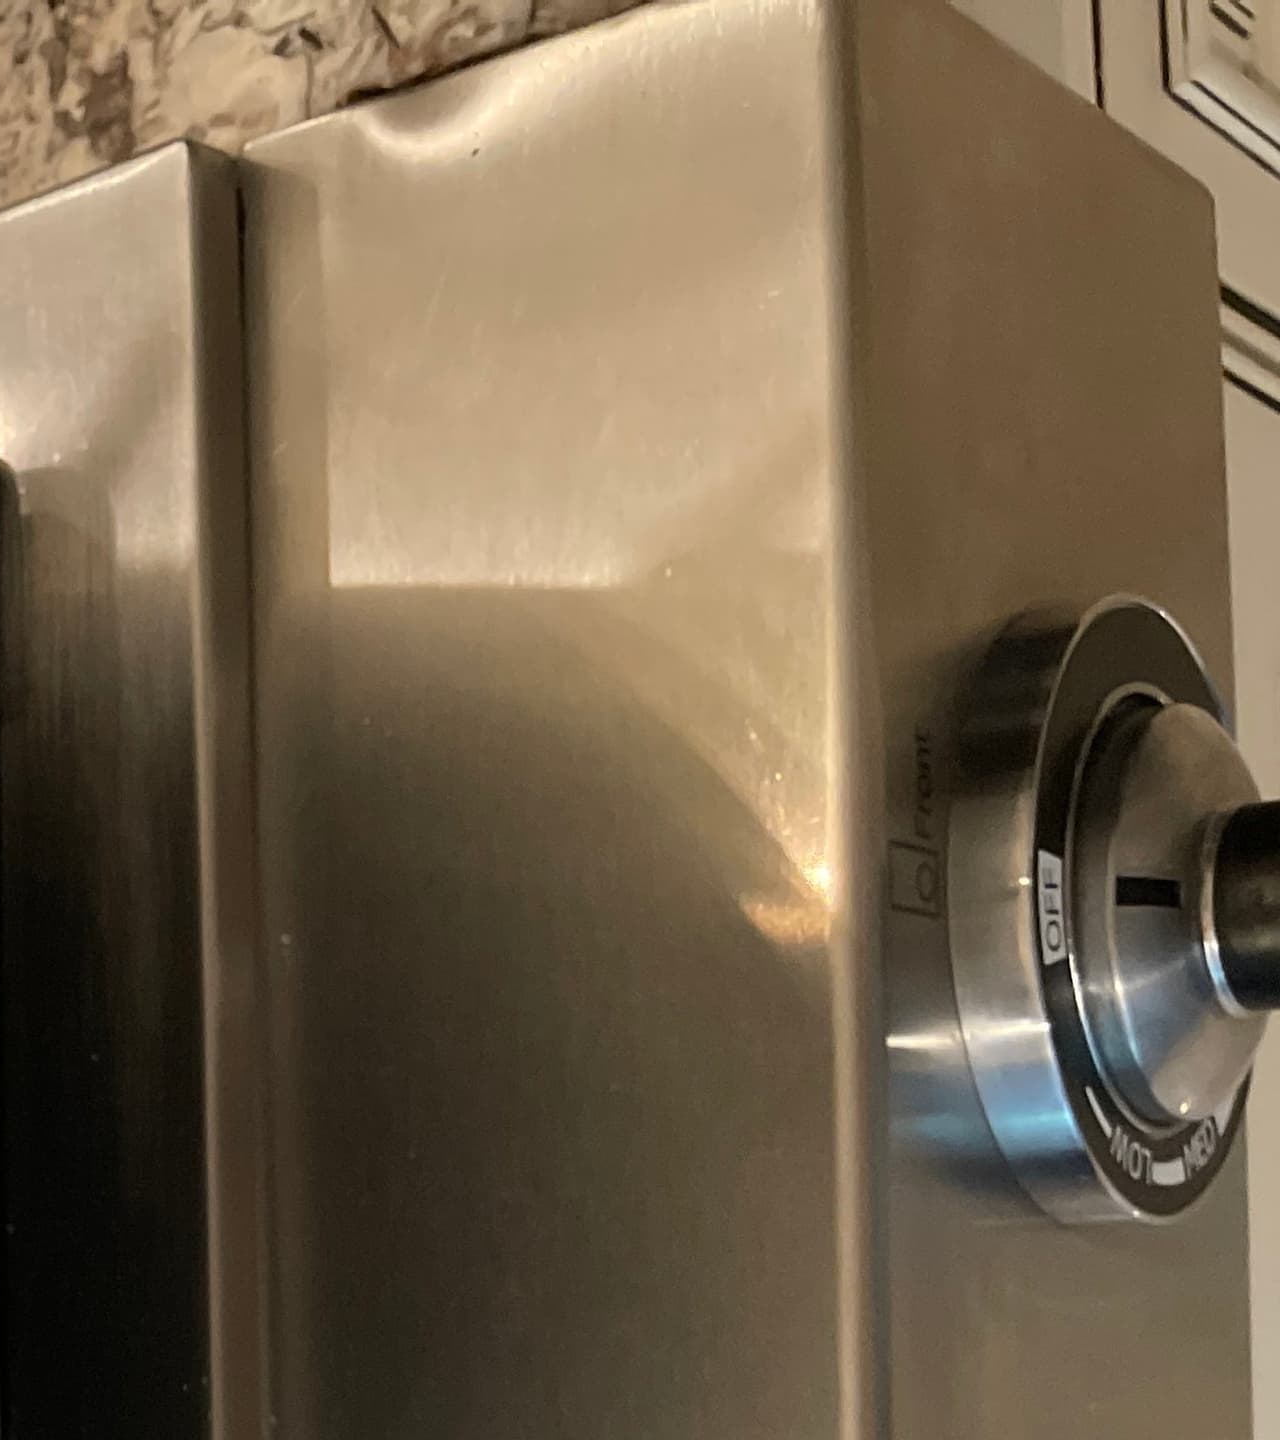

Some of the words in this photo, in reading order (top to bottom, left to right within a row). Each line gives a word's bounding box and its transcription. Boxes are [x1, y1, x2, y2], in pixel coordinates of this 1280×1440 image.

[1043, 866, 1061, 951] OFF
[1110, 1124, 1151, 1185] LOW
[1184, 1116, 1216, 1180] MED
